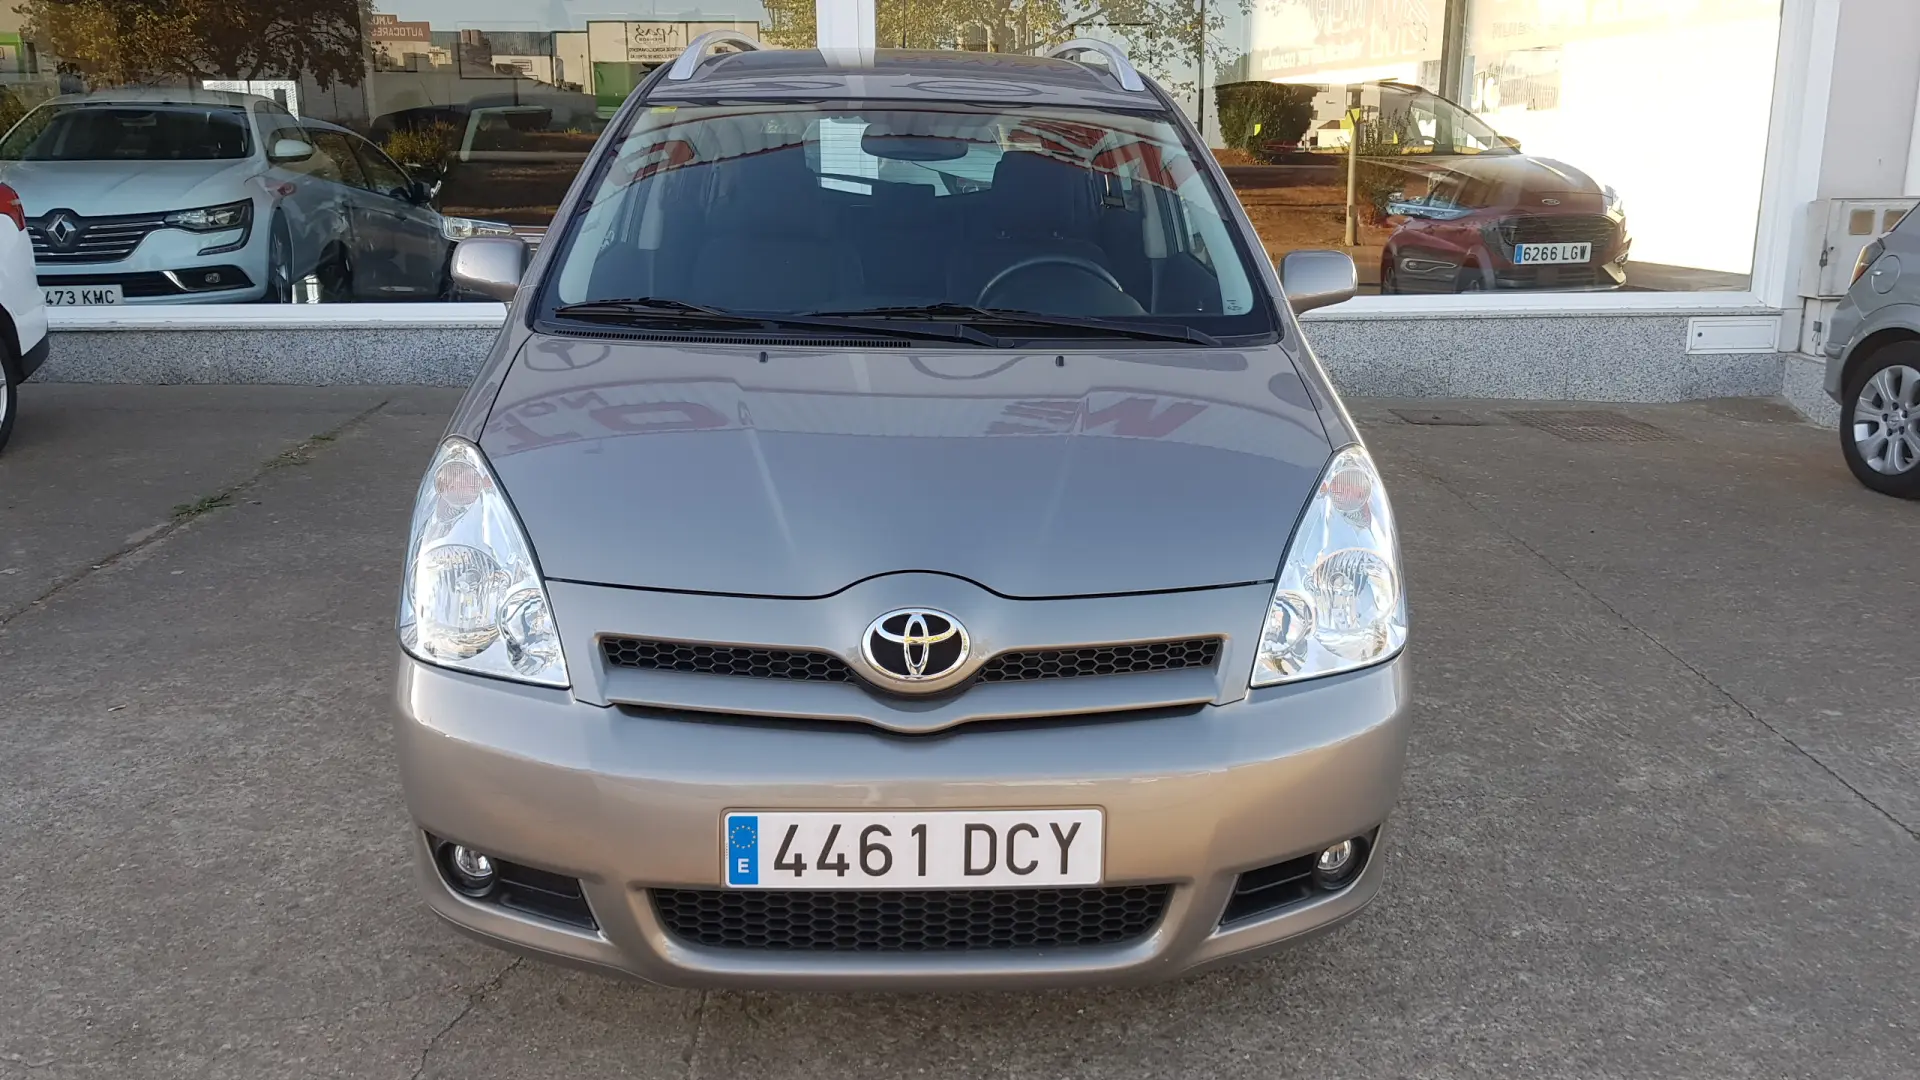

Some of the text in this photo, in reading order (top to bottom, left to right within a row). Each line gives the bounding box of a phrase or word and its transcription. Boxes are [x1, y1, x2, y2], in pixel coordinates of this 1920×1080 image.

[1523, 245, 1587, 261] 6266 LGW
[82, 290, 115, 305] KMC
[737, 822, 1082, 877] E 4461 DCY
